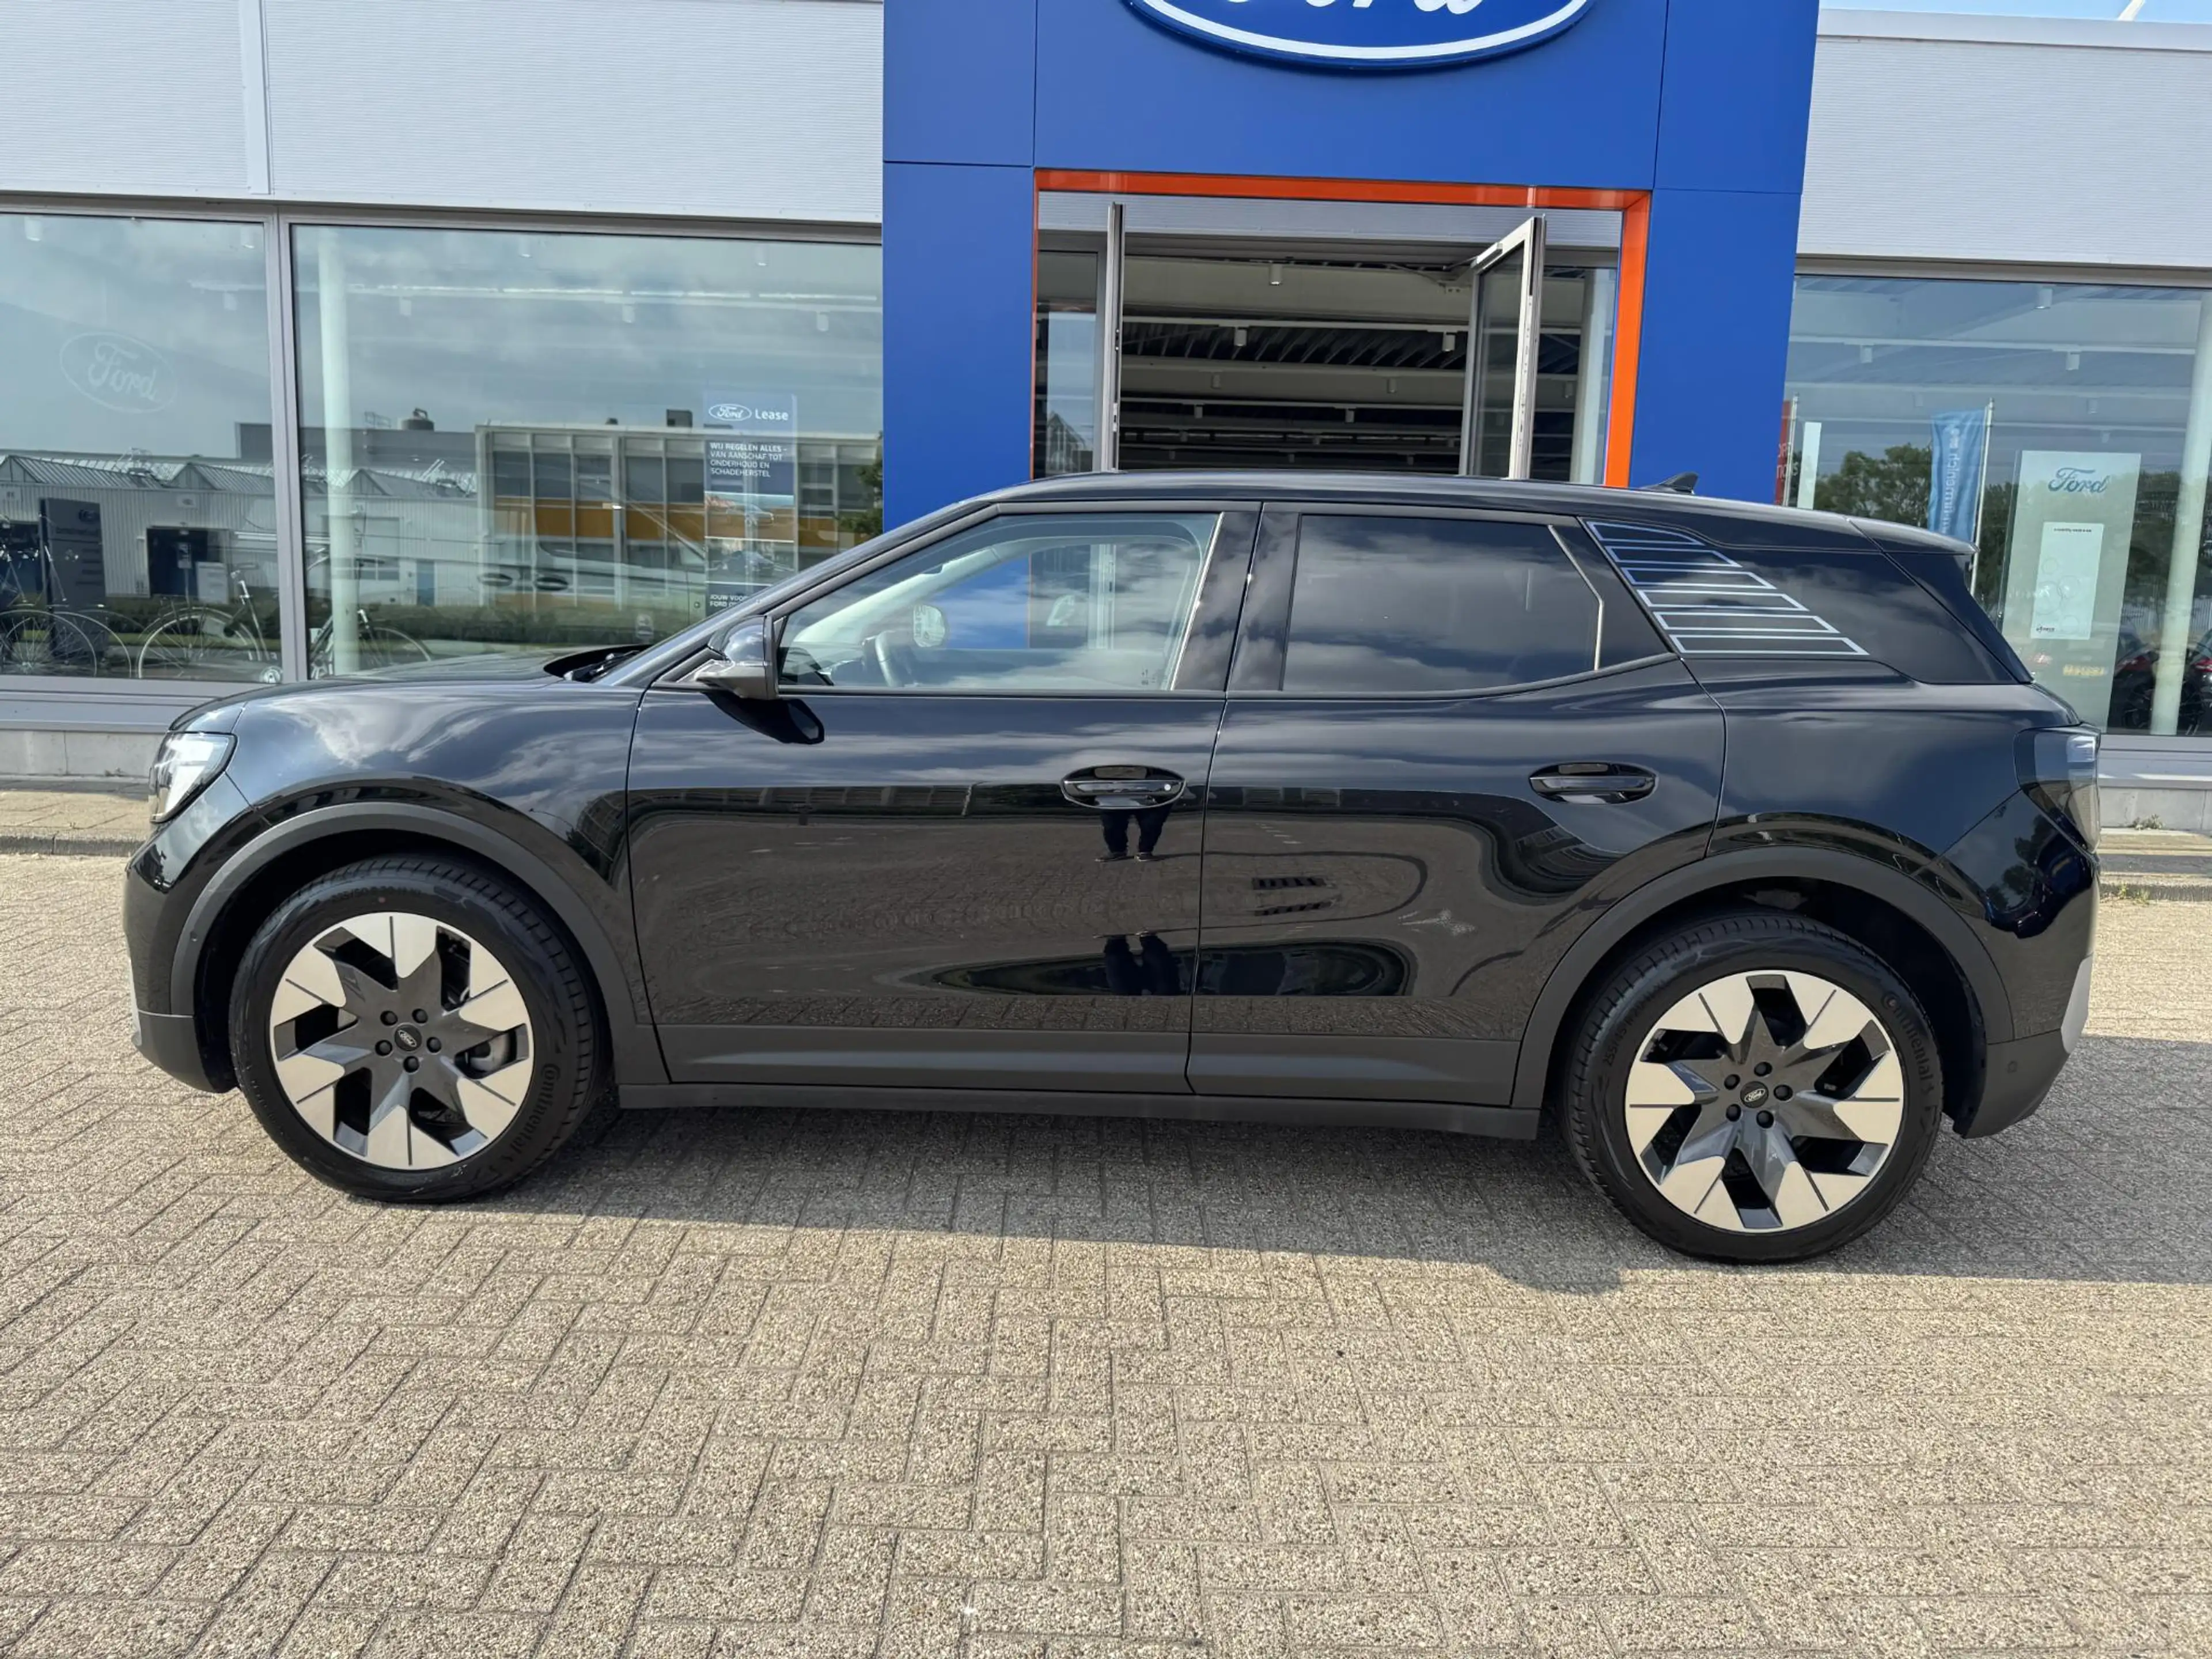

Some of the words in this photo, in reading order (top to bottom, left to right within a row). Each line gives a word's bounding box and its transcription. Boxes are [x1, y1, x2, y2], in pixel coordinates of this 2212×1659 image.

[88, 342, 161, 402] Ford
[717, 406, 744, 419] Ford
[755, 408, 789, 421] Lease
[725, 442, 758, 452] REGELEN
[760, 444, 782, 452] ALLES
[728, 451, 767, 460] AANSCHAF
[710, 460, 758, 468] ONDERHOUD
[711, 468, 771, 478] SCHADEHERSTEL
[2048, 467, 2110, 493] Ford
[509, 1063, 560, 1154] Continental
